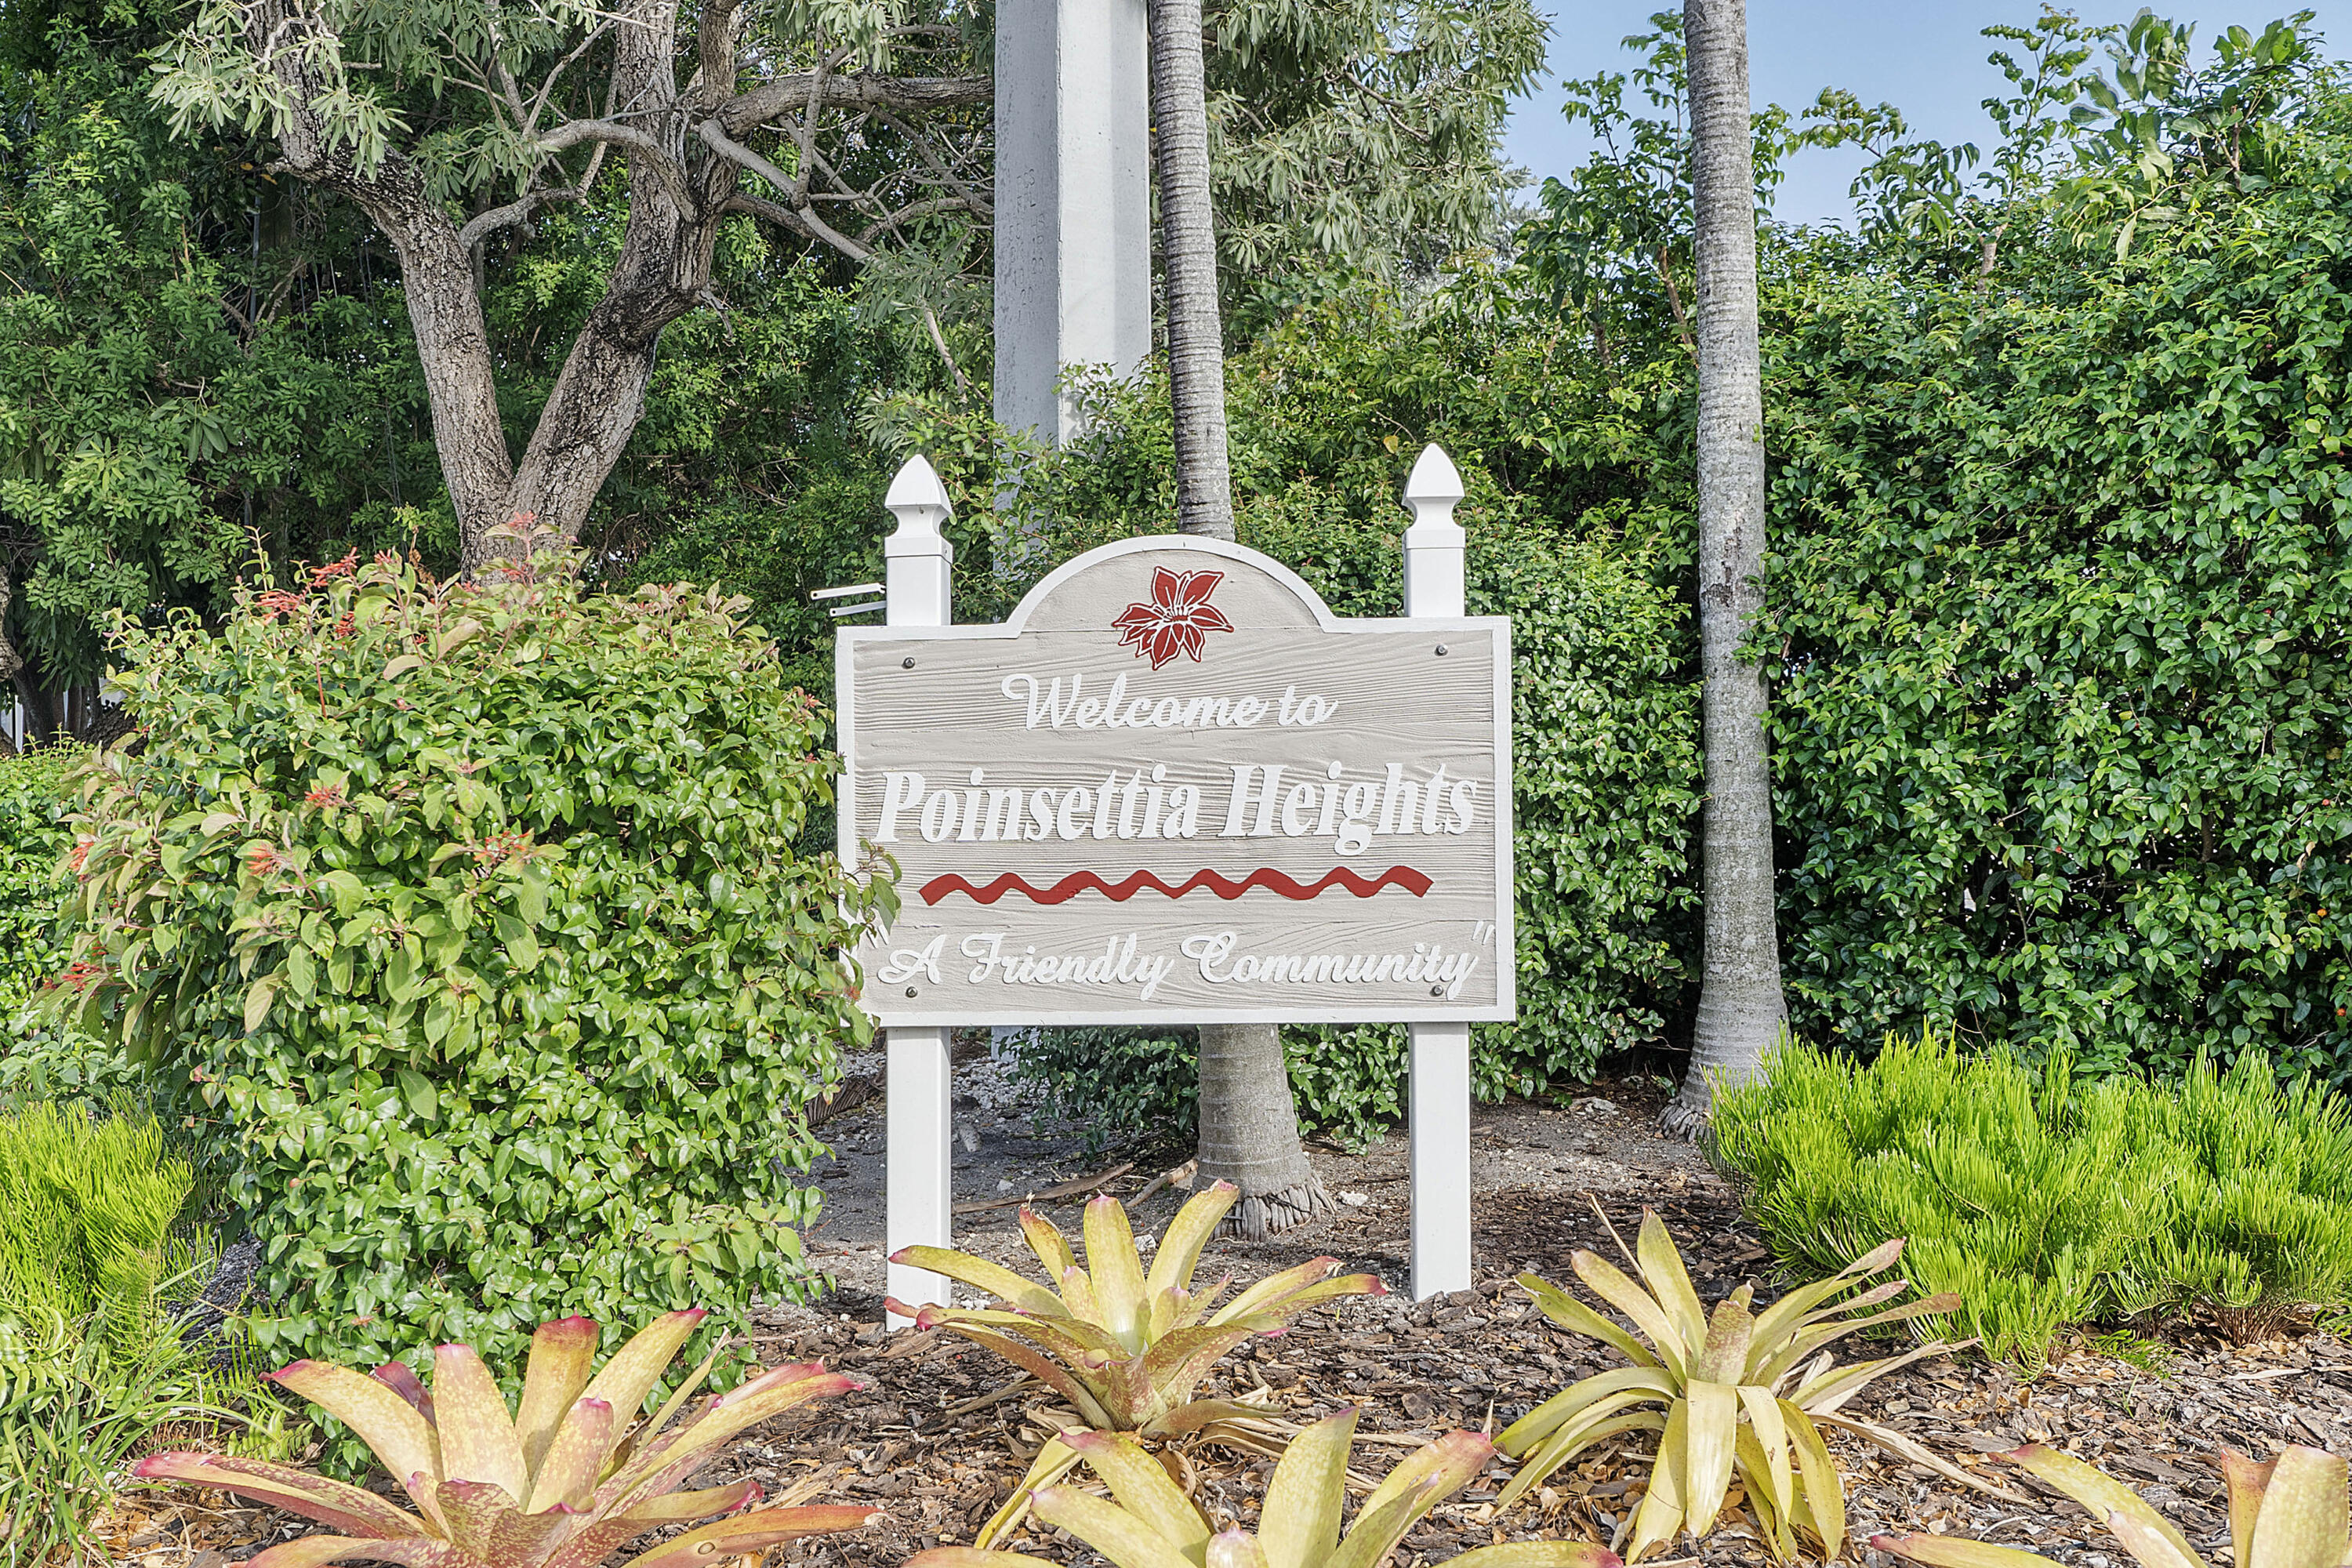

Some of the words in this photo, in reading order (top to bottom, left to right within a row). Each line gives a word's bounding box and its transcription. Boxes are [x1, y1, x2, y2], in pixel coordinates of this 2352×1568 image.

[1001, 672, 1271, 731] Welcome
[1279, 684, 1338, 727] to
[873, 763, 1201, 844] Poinsettia
[1217, 760, 1479, 857] Heights
[959, 931, 1175, 1001] Friendly
[1180, 920, 1496, 1001] Community"
